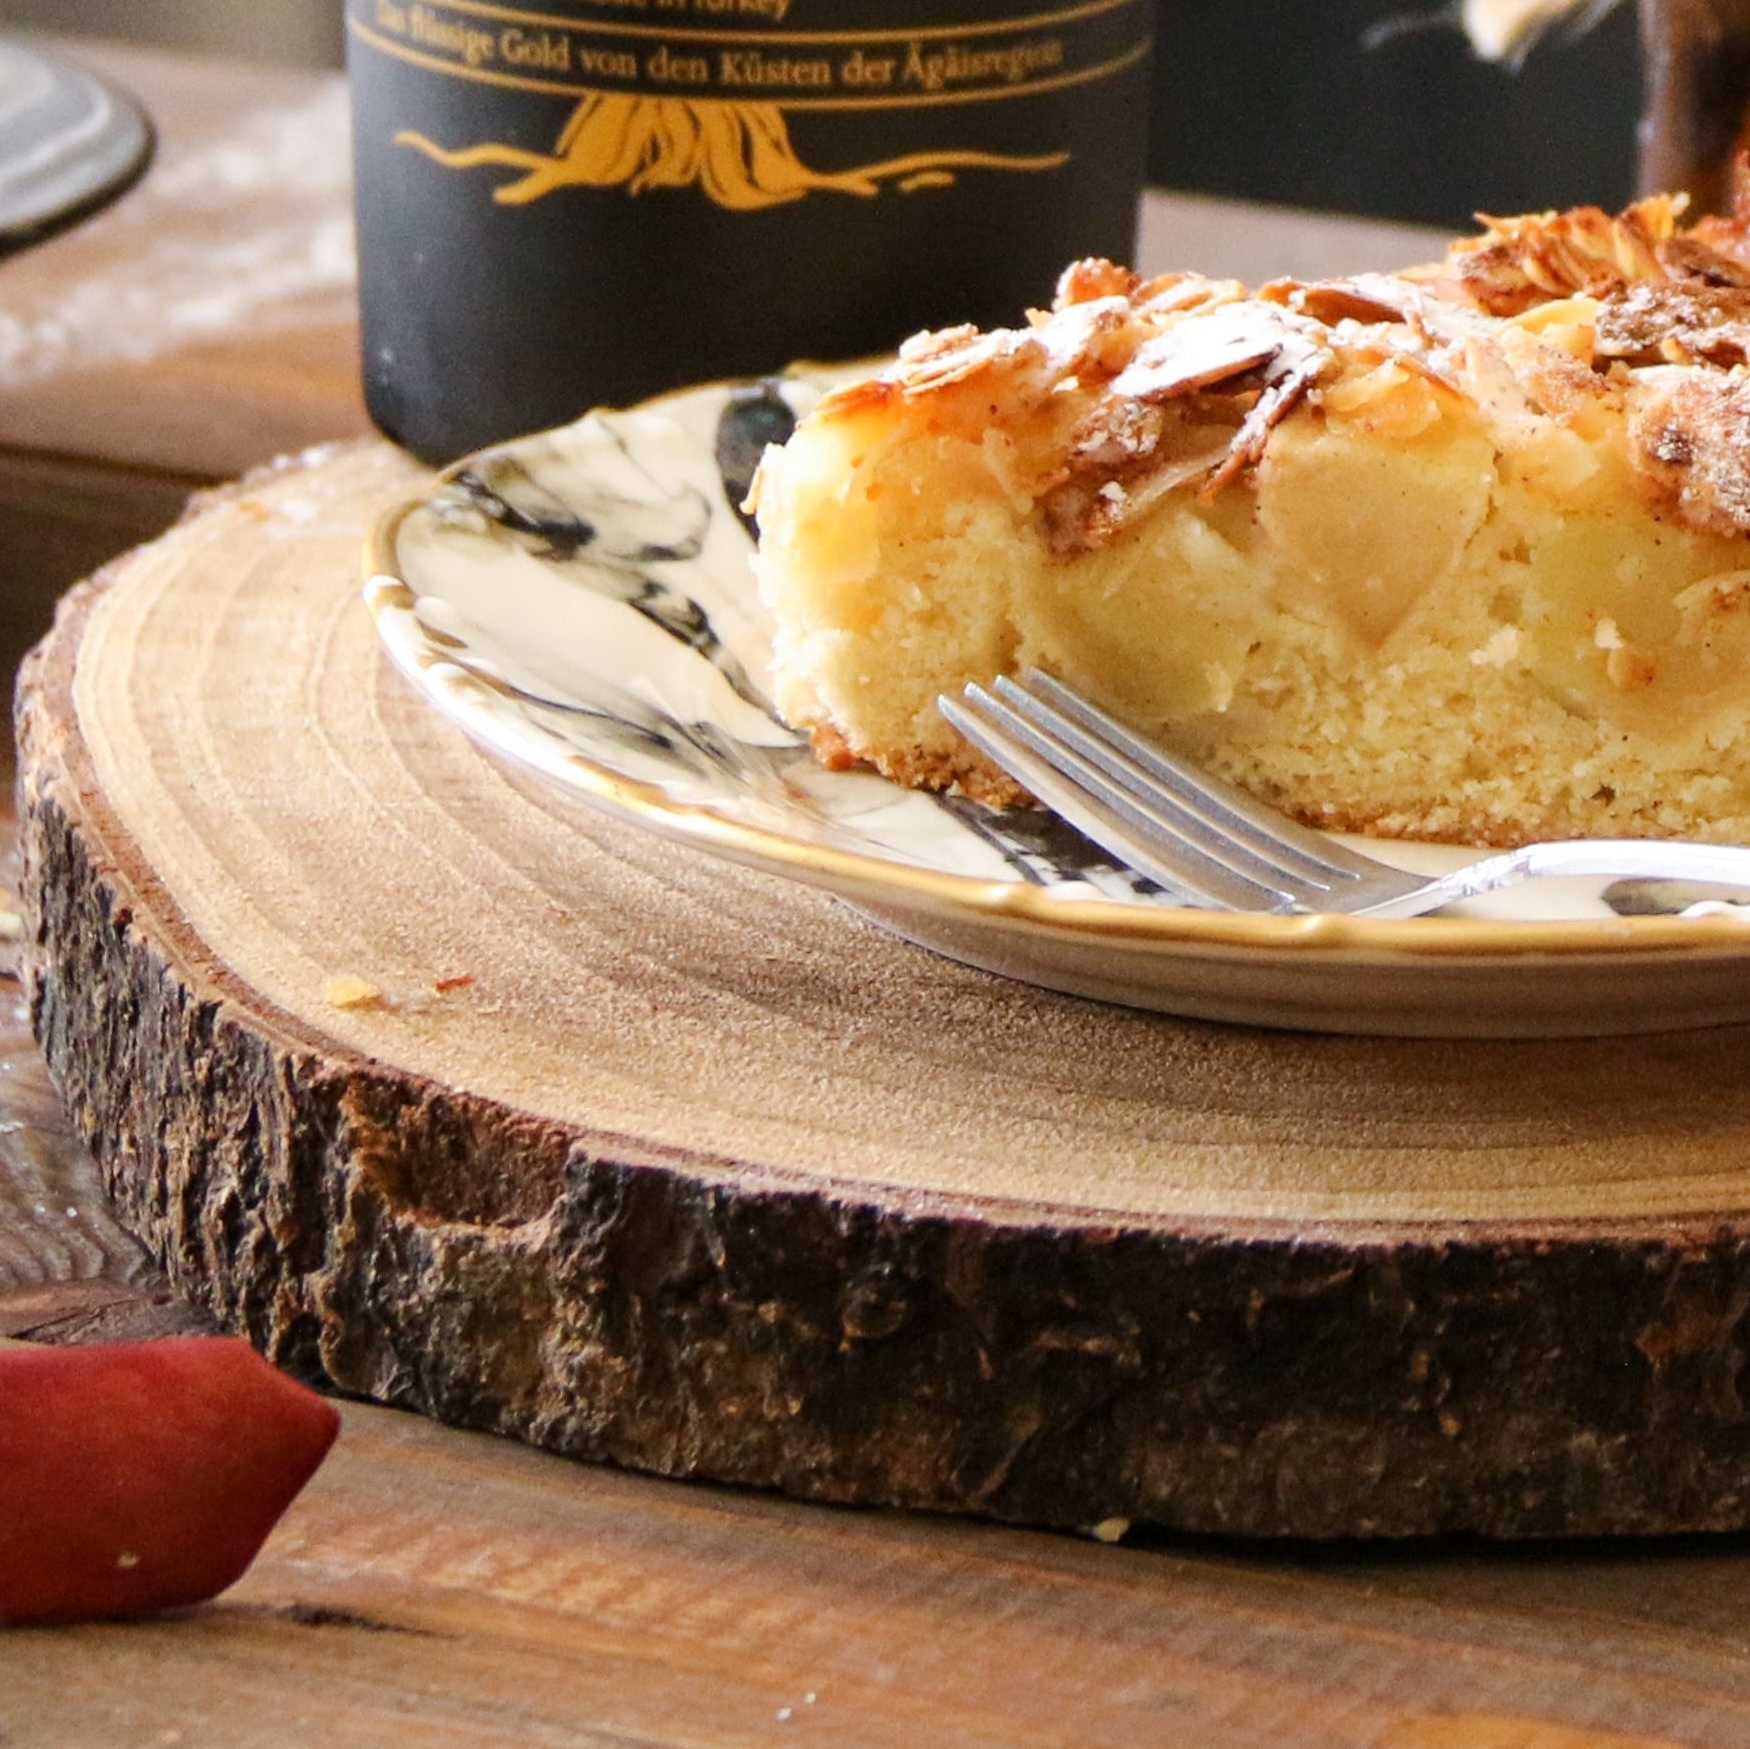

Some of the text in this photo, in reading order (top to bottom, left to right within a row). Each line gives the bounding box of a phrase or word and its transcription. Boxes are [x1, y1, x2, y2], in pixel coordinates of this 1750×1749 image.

[499, 28, 571, 70] Gold
[580, 50, 638, 79] von
[648, 46, 709, 81] den
[721, 49, 832, 85] Küsten
[841, 51, 896, 84] der
